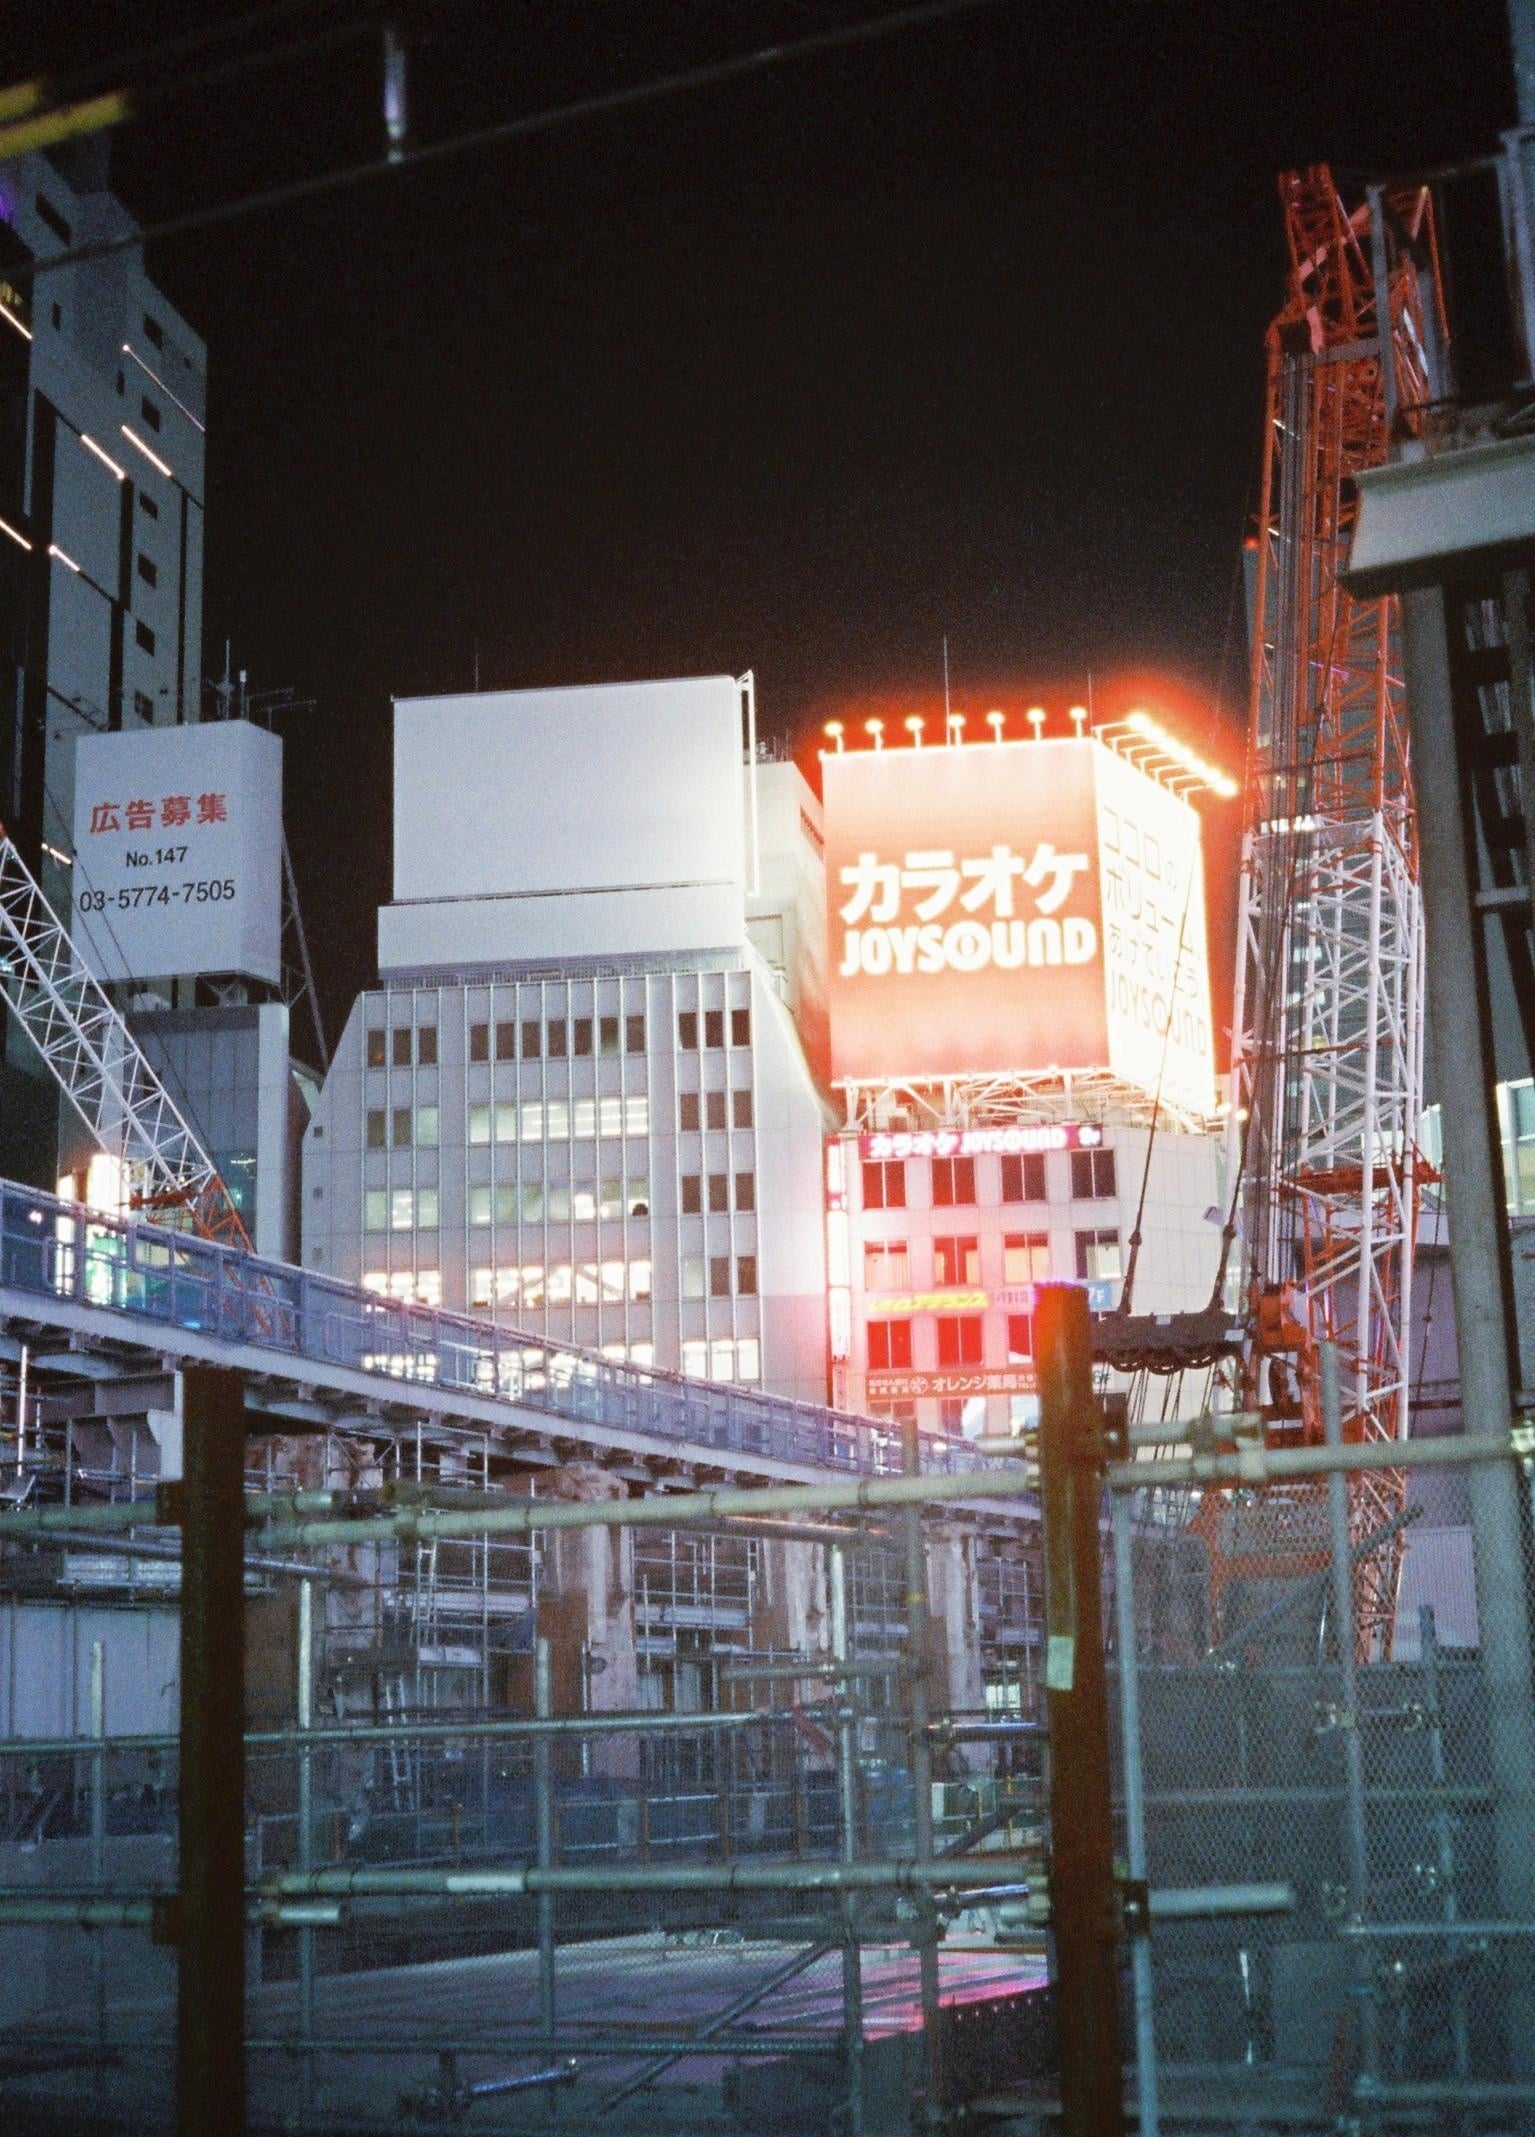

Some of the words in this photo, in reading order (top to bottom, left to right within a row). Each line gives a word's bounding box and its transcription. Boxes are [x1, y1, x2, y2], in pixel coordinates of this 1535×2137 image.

[89, 792, 228, 834] 広告募集
[125, 846, 188, 868] No.147
[79, 879, 235, 913] 03-5774-7505
[838, 842, 1090, 926] カラオケ
[838, 915, 1097, 978] JOYSOUND
[869, 1132, 958, 1158] カラオケ
[961, 1126, 1068, 1153] JOYSOUND
